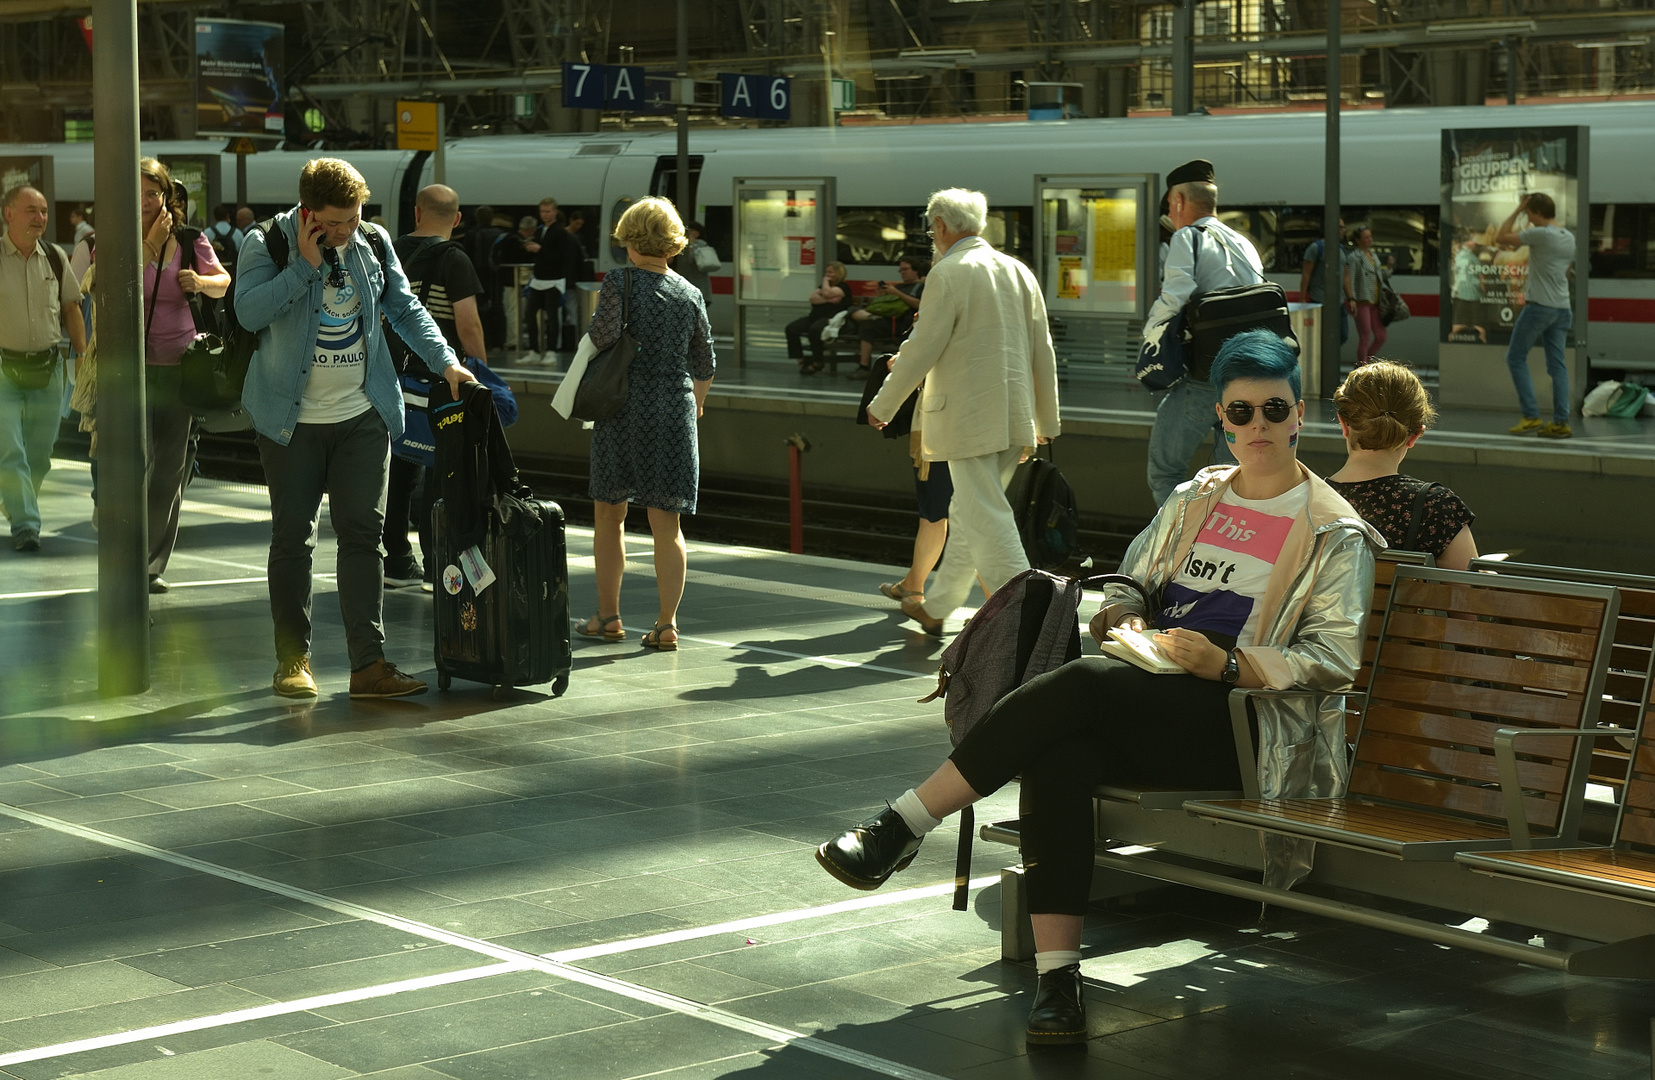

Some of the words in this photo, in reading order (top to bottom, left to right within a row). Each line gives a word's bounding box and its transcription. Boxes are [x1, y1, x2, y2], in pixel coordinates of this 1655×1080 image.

[571, 64, 591, 98] 7
[612, 67, 635, 100] A
[731, 75, 752, 108] A
[769, 78, 787, 110] 6
[1460, 157, 1535, 179] GRUPPEN-
[1460, 173, 1536, 194] KUSCHELN
[1468, 264, 1529, 275] SPORTSCHA
[333, 284, 355, 305] 59
[321, 302, 340, 318] BEACH
[342, 301, 361, 318] SOCCER
[312, 353, 328, 364] AO
[333, 351, 364, 364] PAULO
[402, 438, 436, 452] DONIC
[1205, 511, 1257, 542] This
[1184, 551, 1236, 584] Isn't
